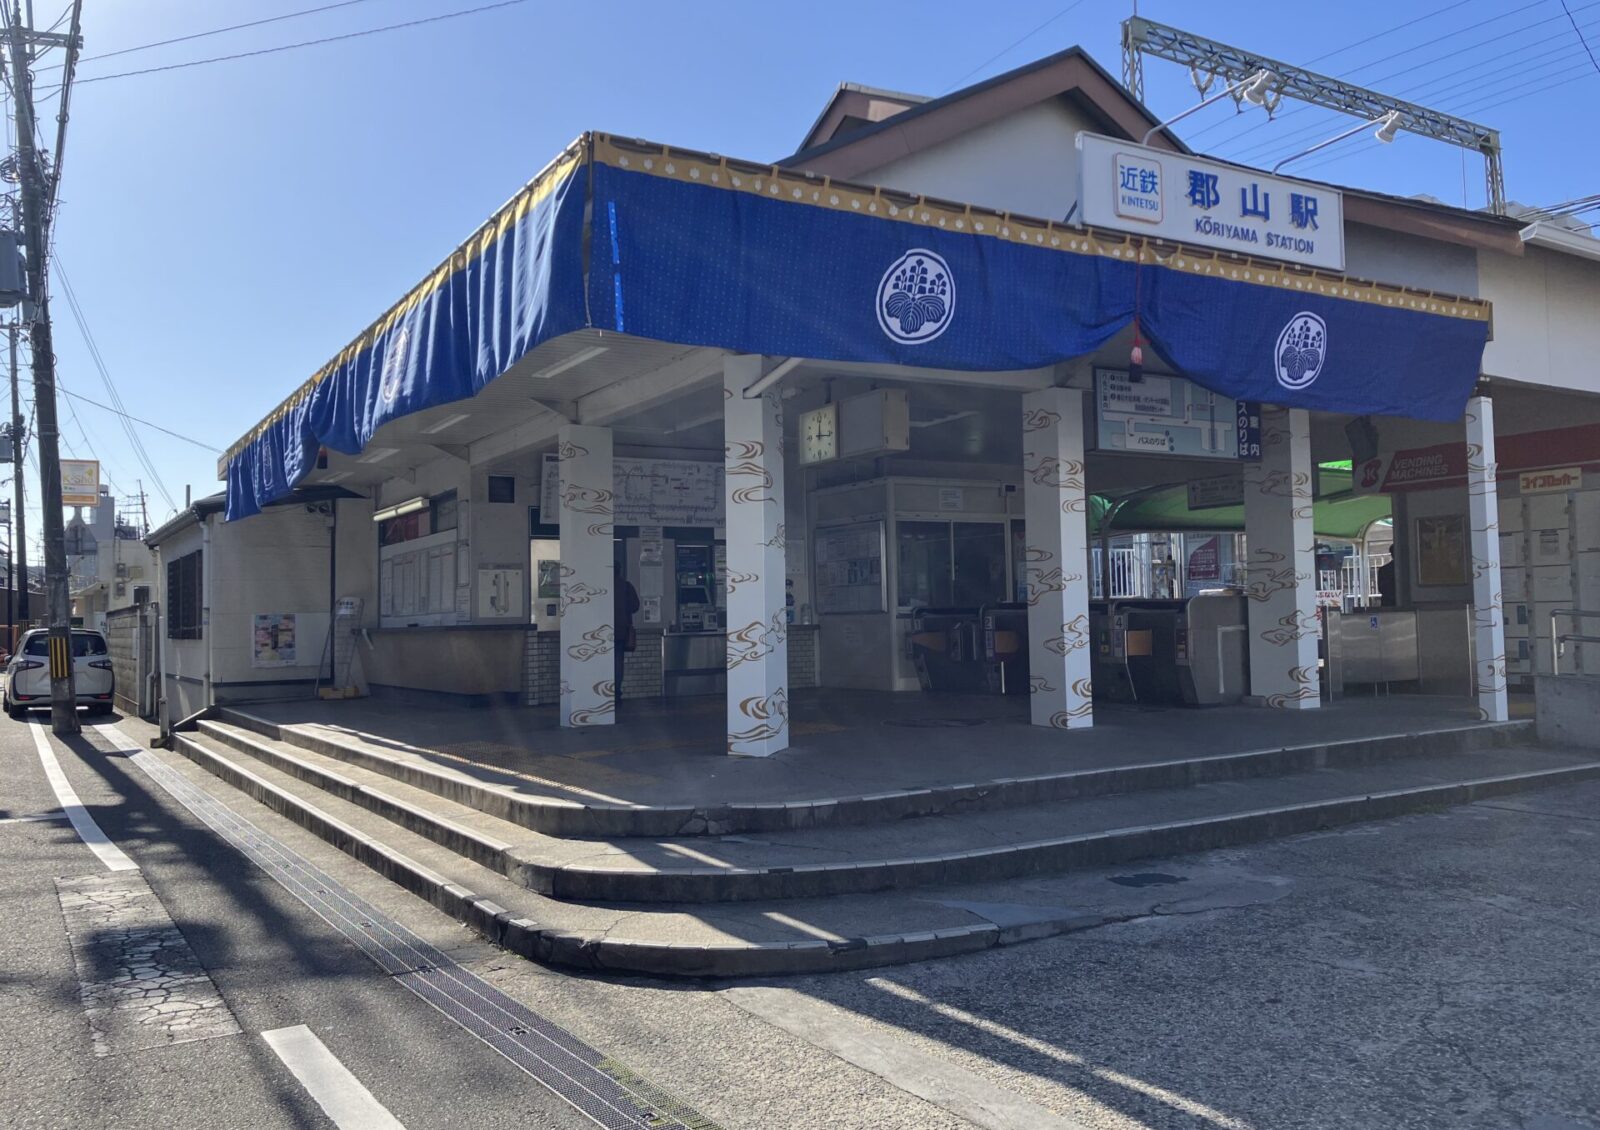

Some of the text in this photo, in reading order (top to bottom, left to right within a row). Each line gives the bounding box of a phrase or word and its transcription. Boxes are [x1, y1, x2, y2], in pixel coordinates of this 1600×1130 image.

[1120, 164, 1159, 196] 近鉄
[1121, 194, 1159, 212] KINTETSU
[1186, 168, 1320, 232] 郡山駅
[1266, 232, 1315, 254] STATION
[1394, 453, 1443, 469] VENDING
[1391, 464, 1449, 480] MACHINES
[984, 617, 991, 628] 2
[1115, 617, 1123, 628] 4
